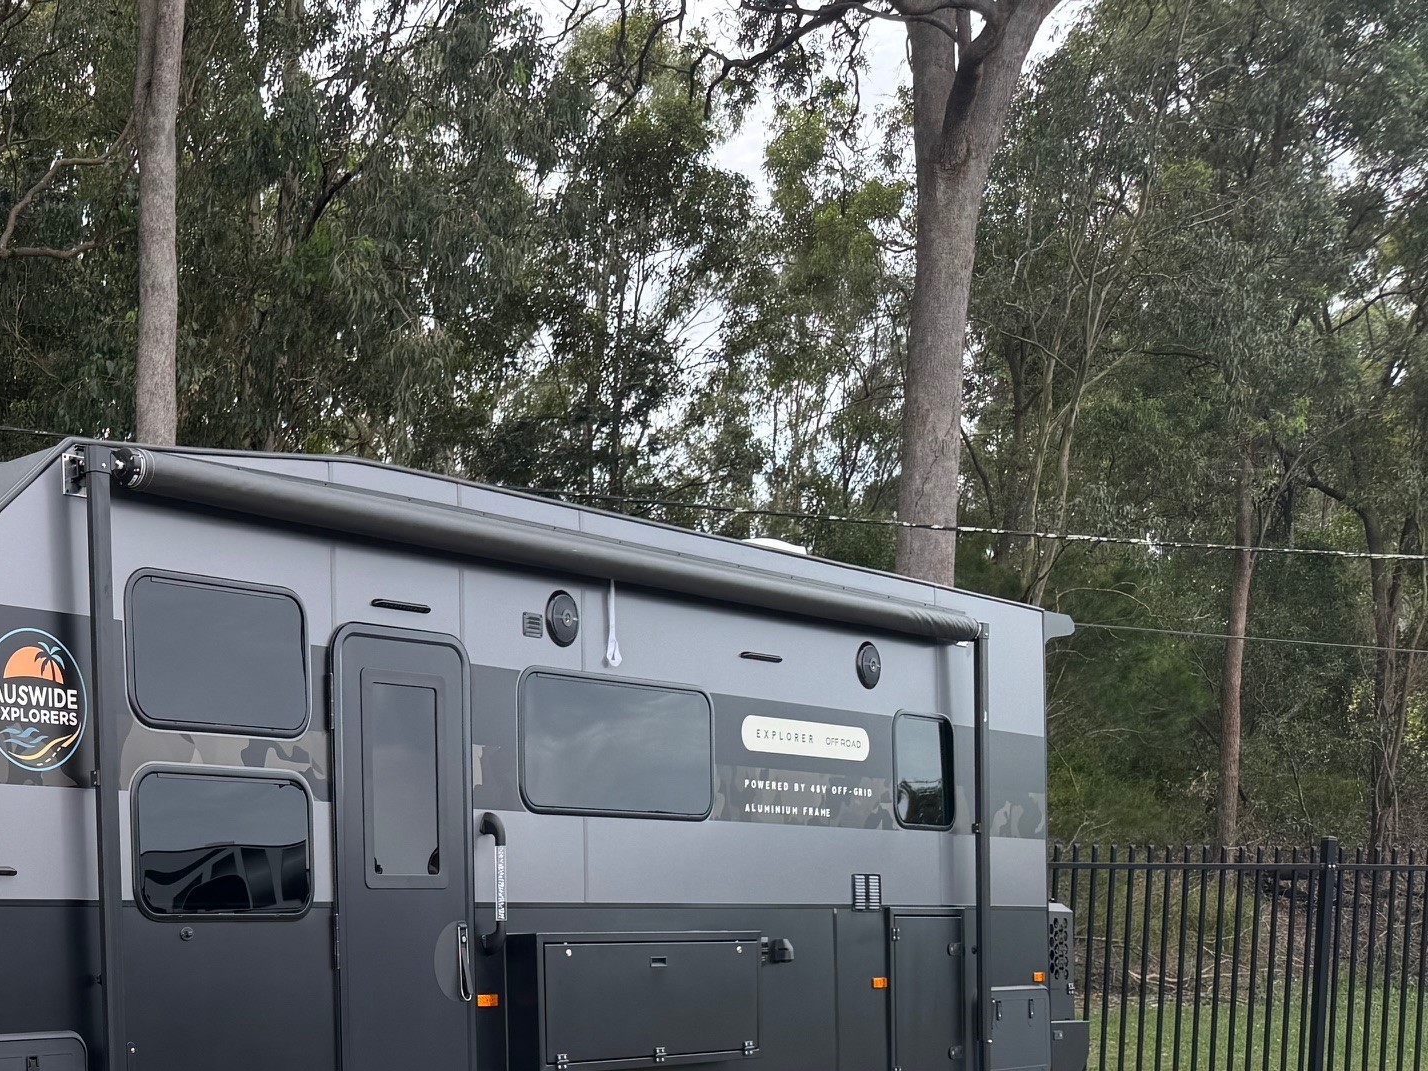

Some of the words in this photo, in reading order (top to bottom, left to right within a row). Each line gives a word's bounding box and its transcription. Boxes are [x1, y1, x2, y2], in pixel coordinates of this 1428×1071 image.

[756, 728, 814, 744] EXPLORER
[744, 779, 789, 791] POWERED
[794, 783, 805, 792] BY
[810, 784, 827, 795] 48V
[831, 786, 873, 798] OFF-GRID
[744, 803, 798, 816] ALUMINIUM
[802, 806, 831, 818] FRAME
